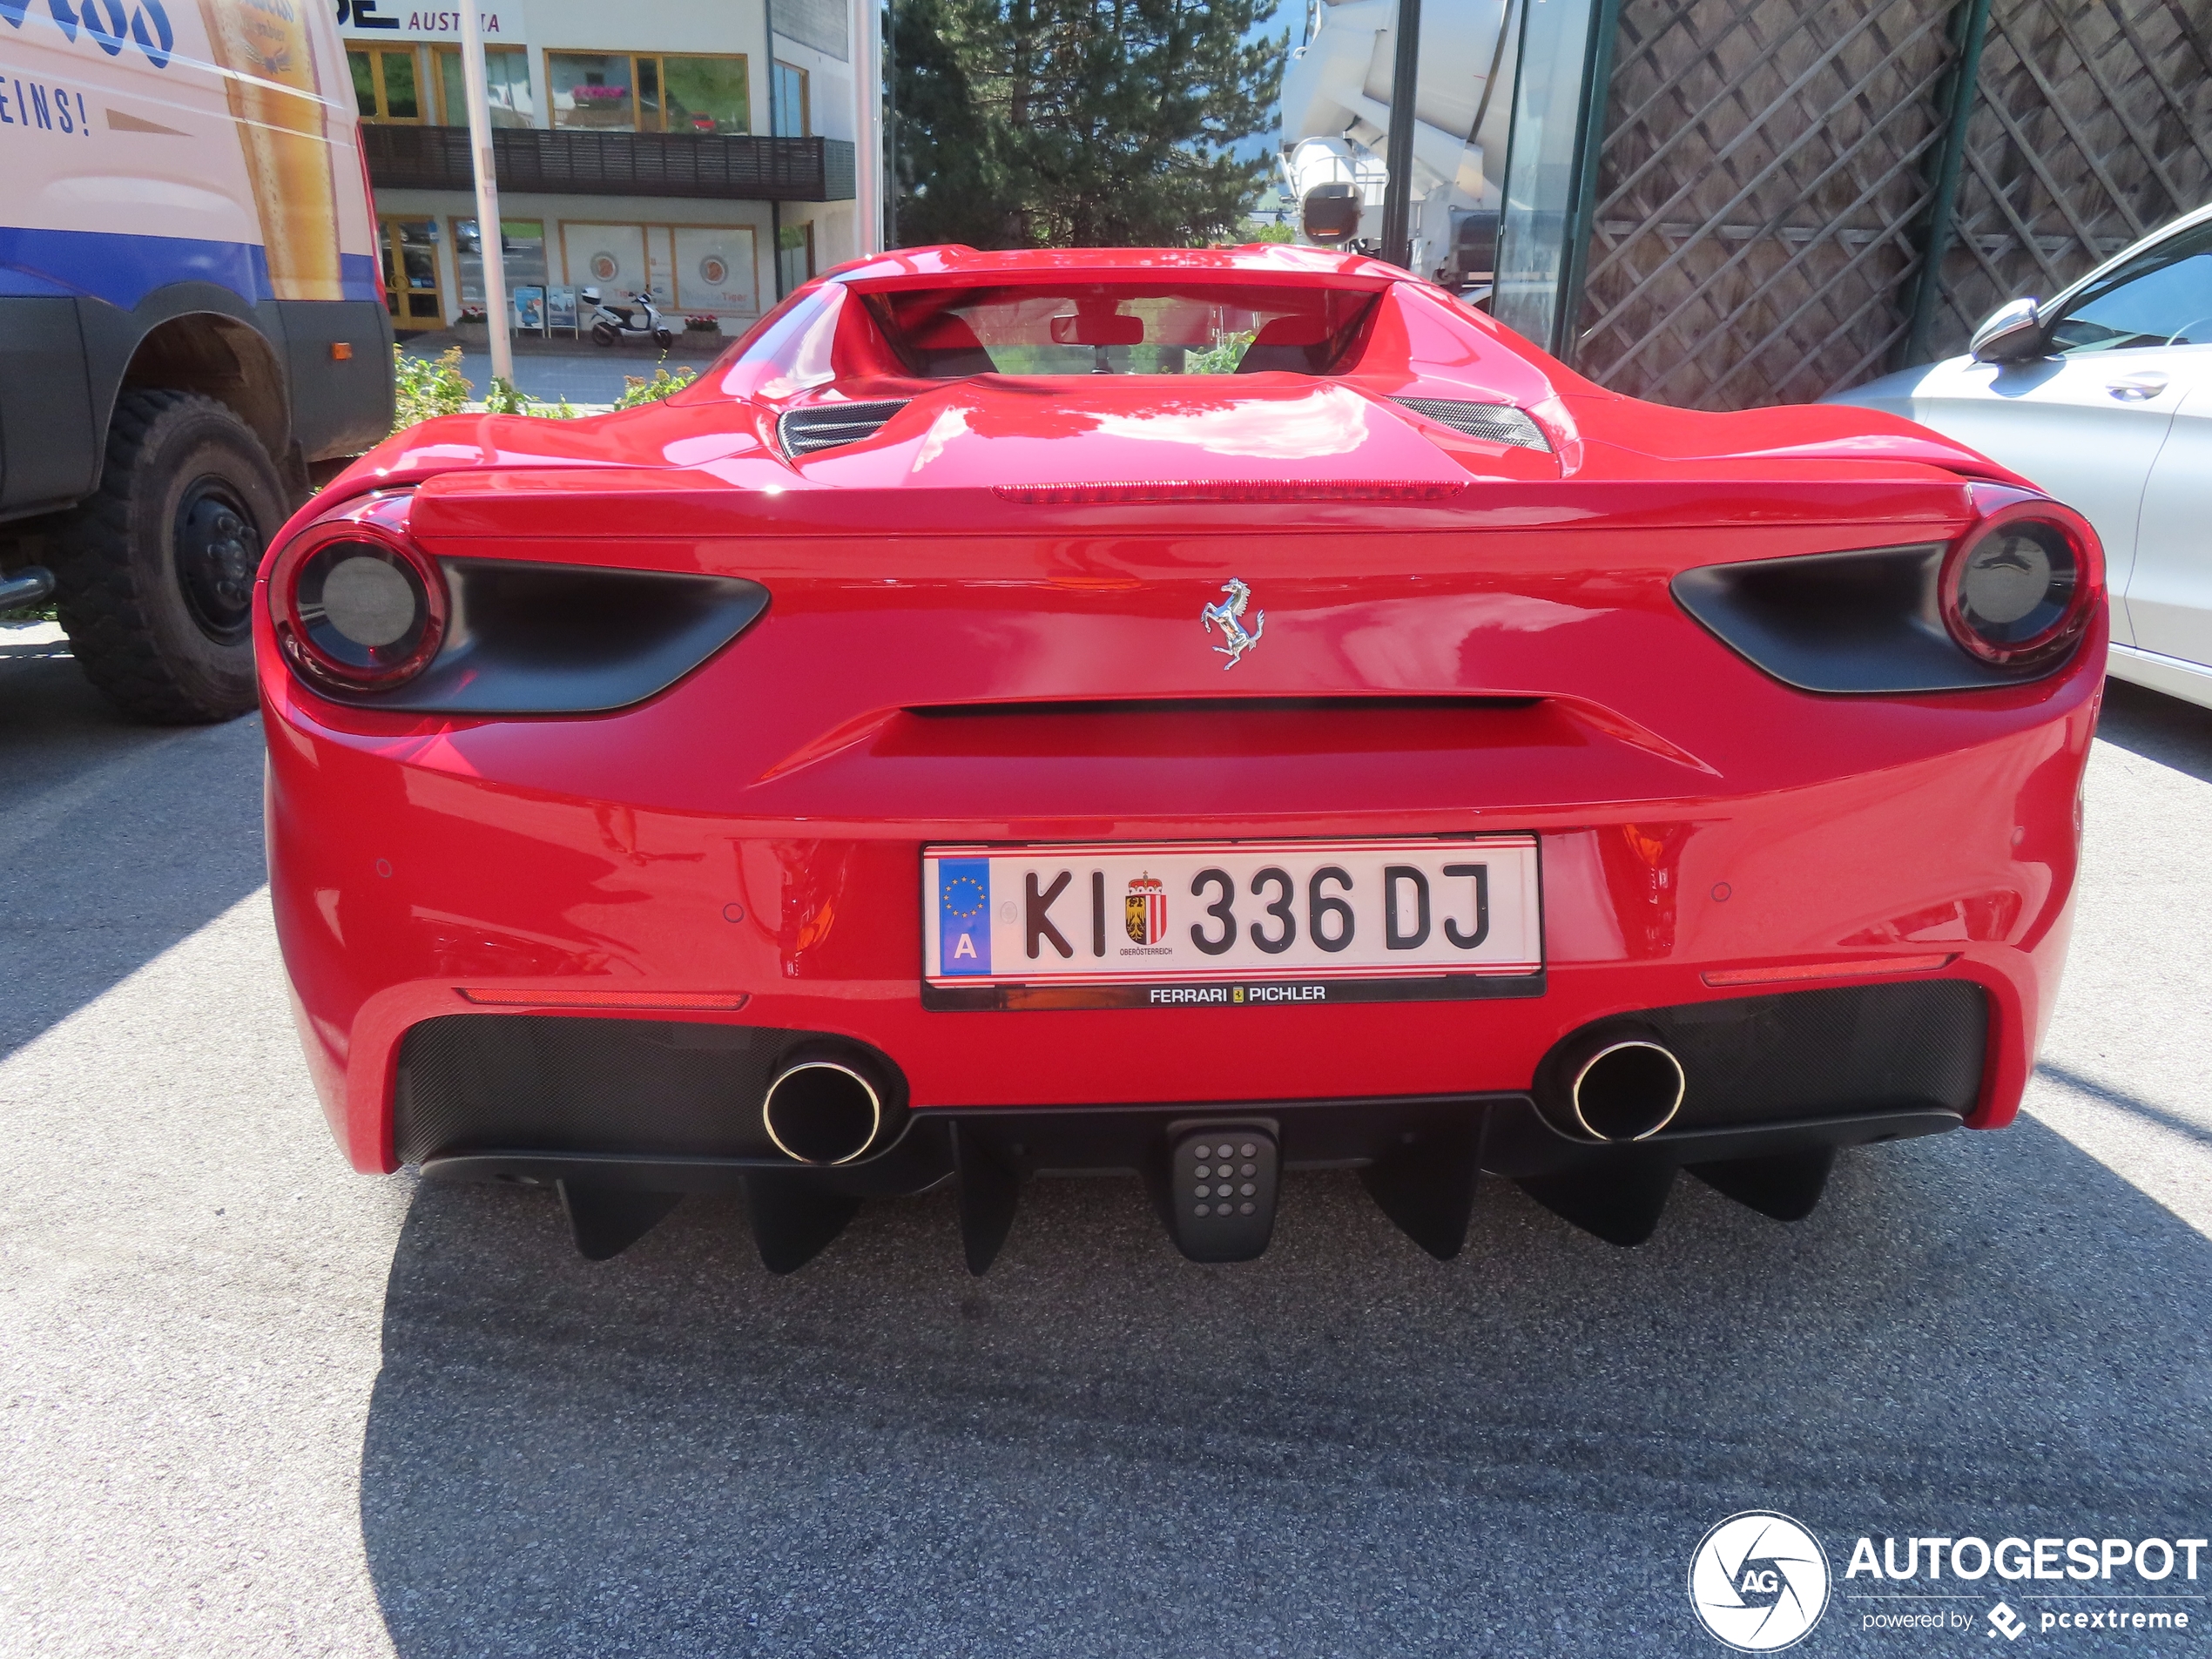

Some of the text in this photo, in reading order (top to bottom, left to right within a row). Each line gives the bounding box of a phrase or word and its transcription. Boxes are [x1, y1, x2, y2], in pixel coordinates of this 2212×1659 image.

[408, 11, 500, 32] AUSTIA
[1026, 864, 1490, 959] KI 336 DJ
[954, 933, 977, 959] A
[1119, 947, 1173, 956] OBERÖSTERREICH
[1150, 986, 1325, 1003] FERRARI PICHLER
